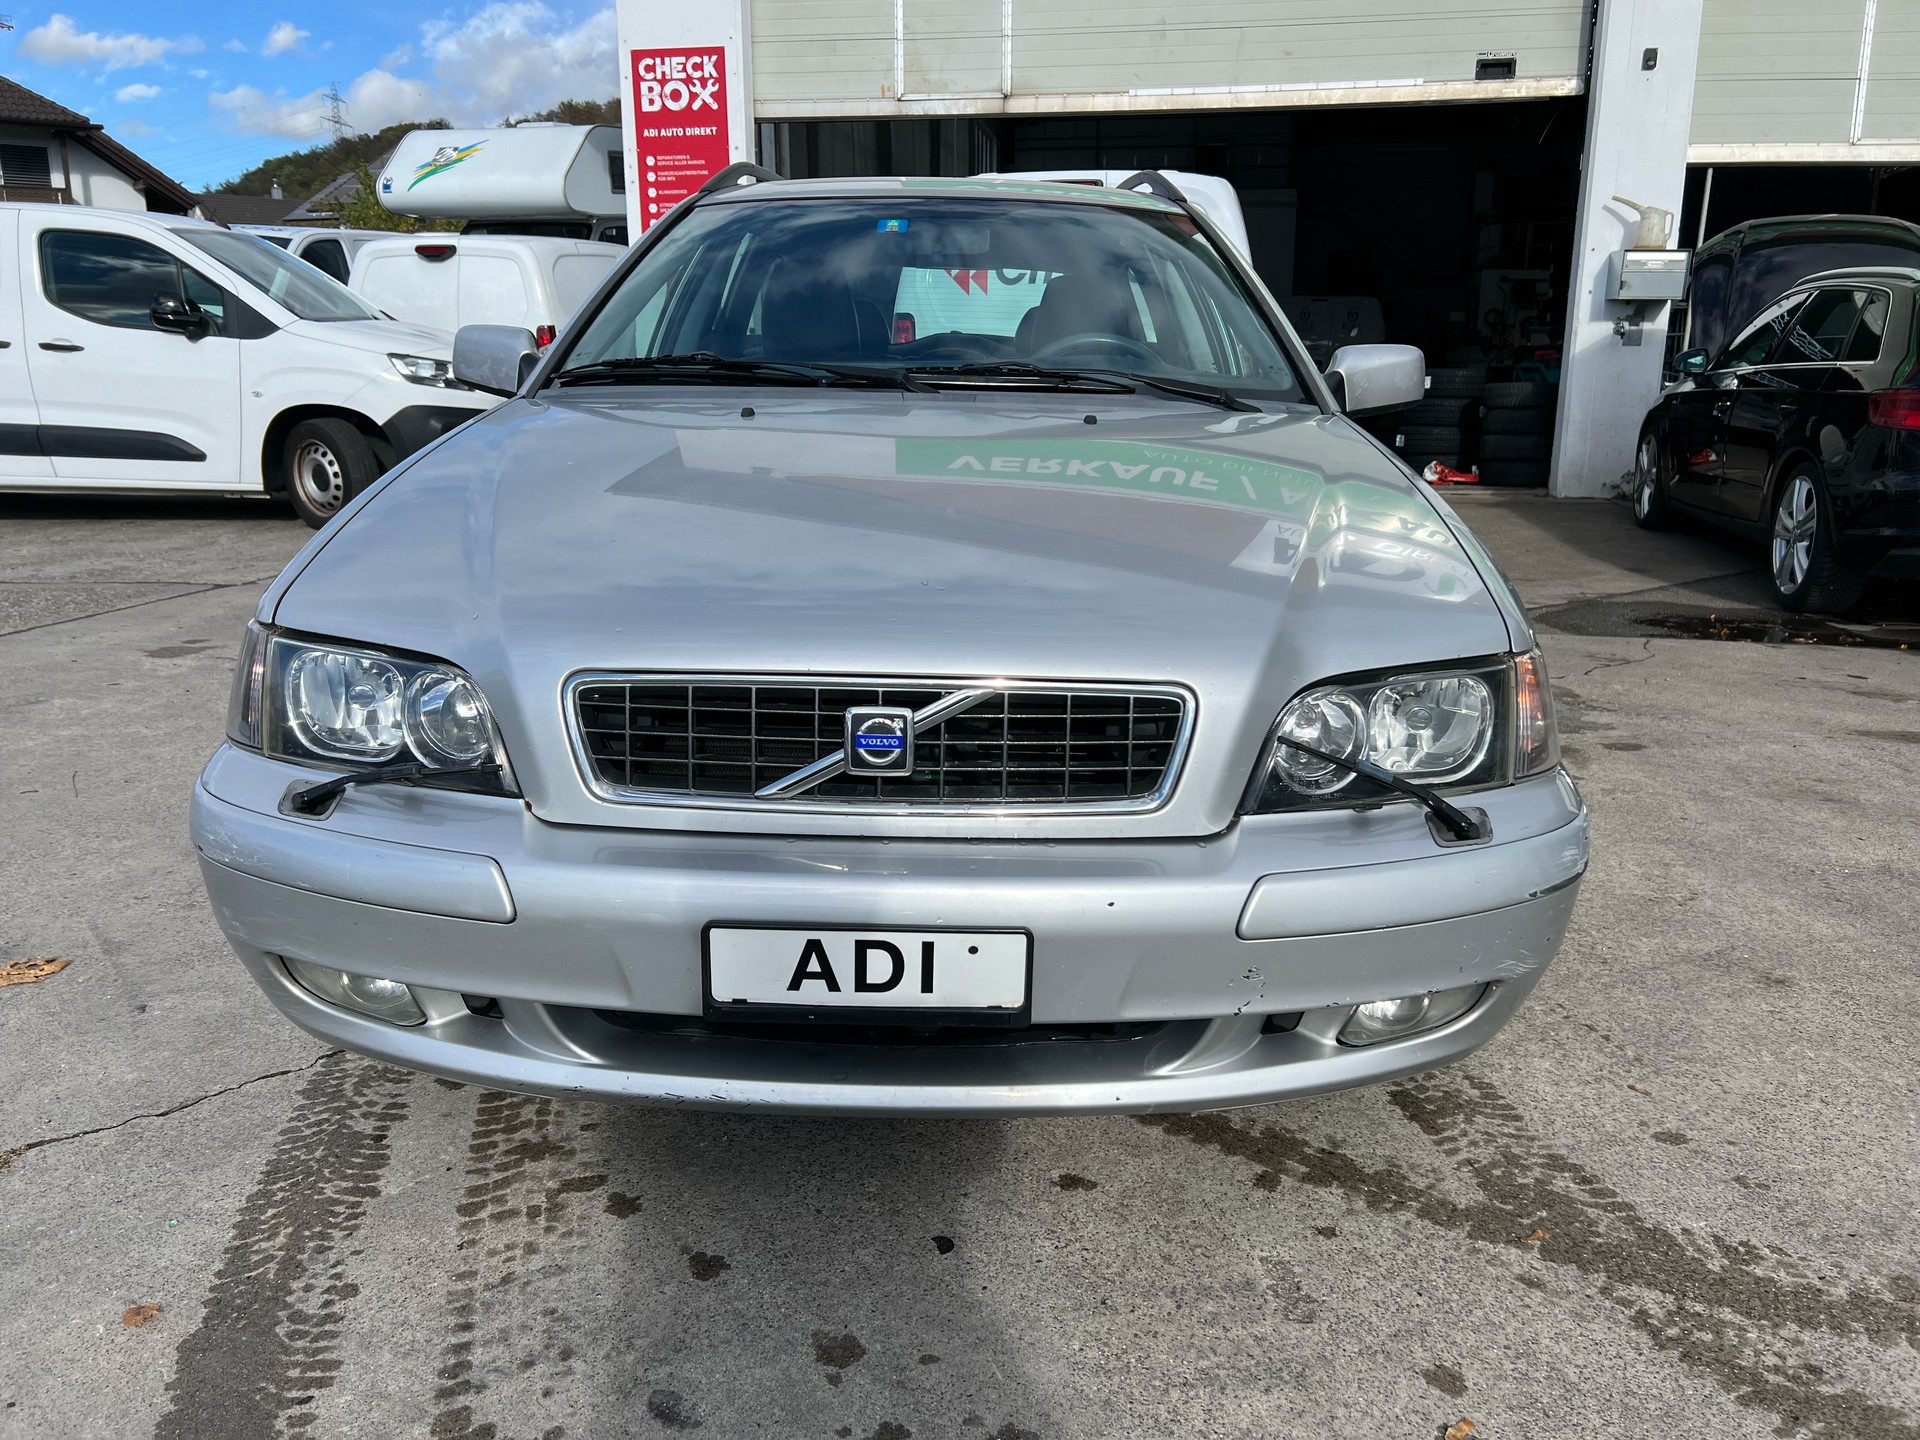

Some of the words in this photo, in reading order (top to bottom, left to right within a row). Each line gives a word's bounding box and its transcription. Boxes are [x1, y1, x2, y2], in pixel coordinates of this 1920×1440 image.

[638, 55, 719, 80] CHECK
[640, 79, 720, 113] BOX
[643, 128, 659, 137] ADI
[660, 127, 684, 137] AUTO
[685, 126, 718, 136] DIREKT
[859, 738, 899, 746] VOLVO
[786, 938, 936, 994] ADI
